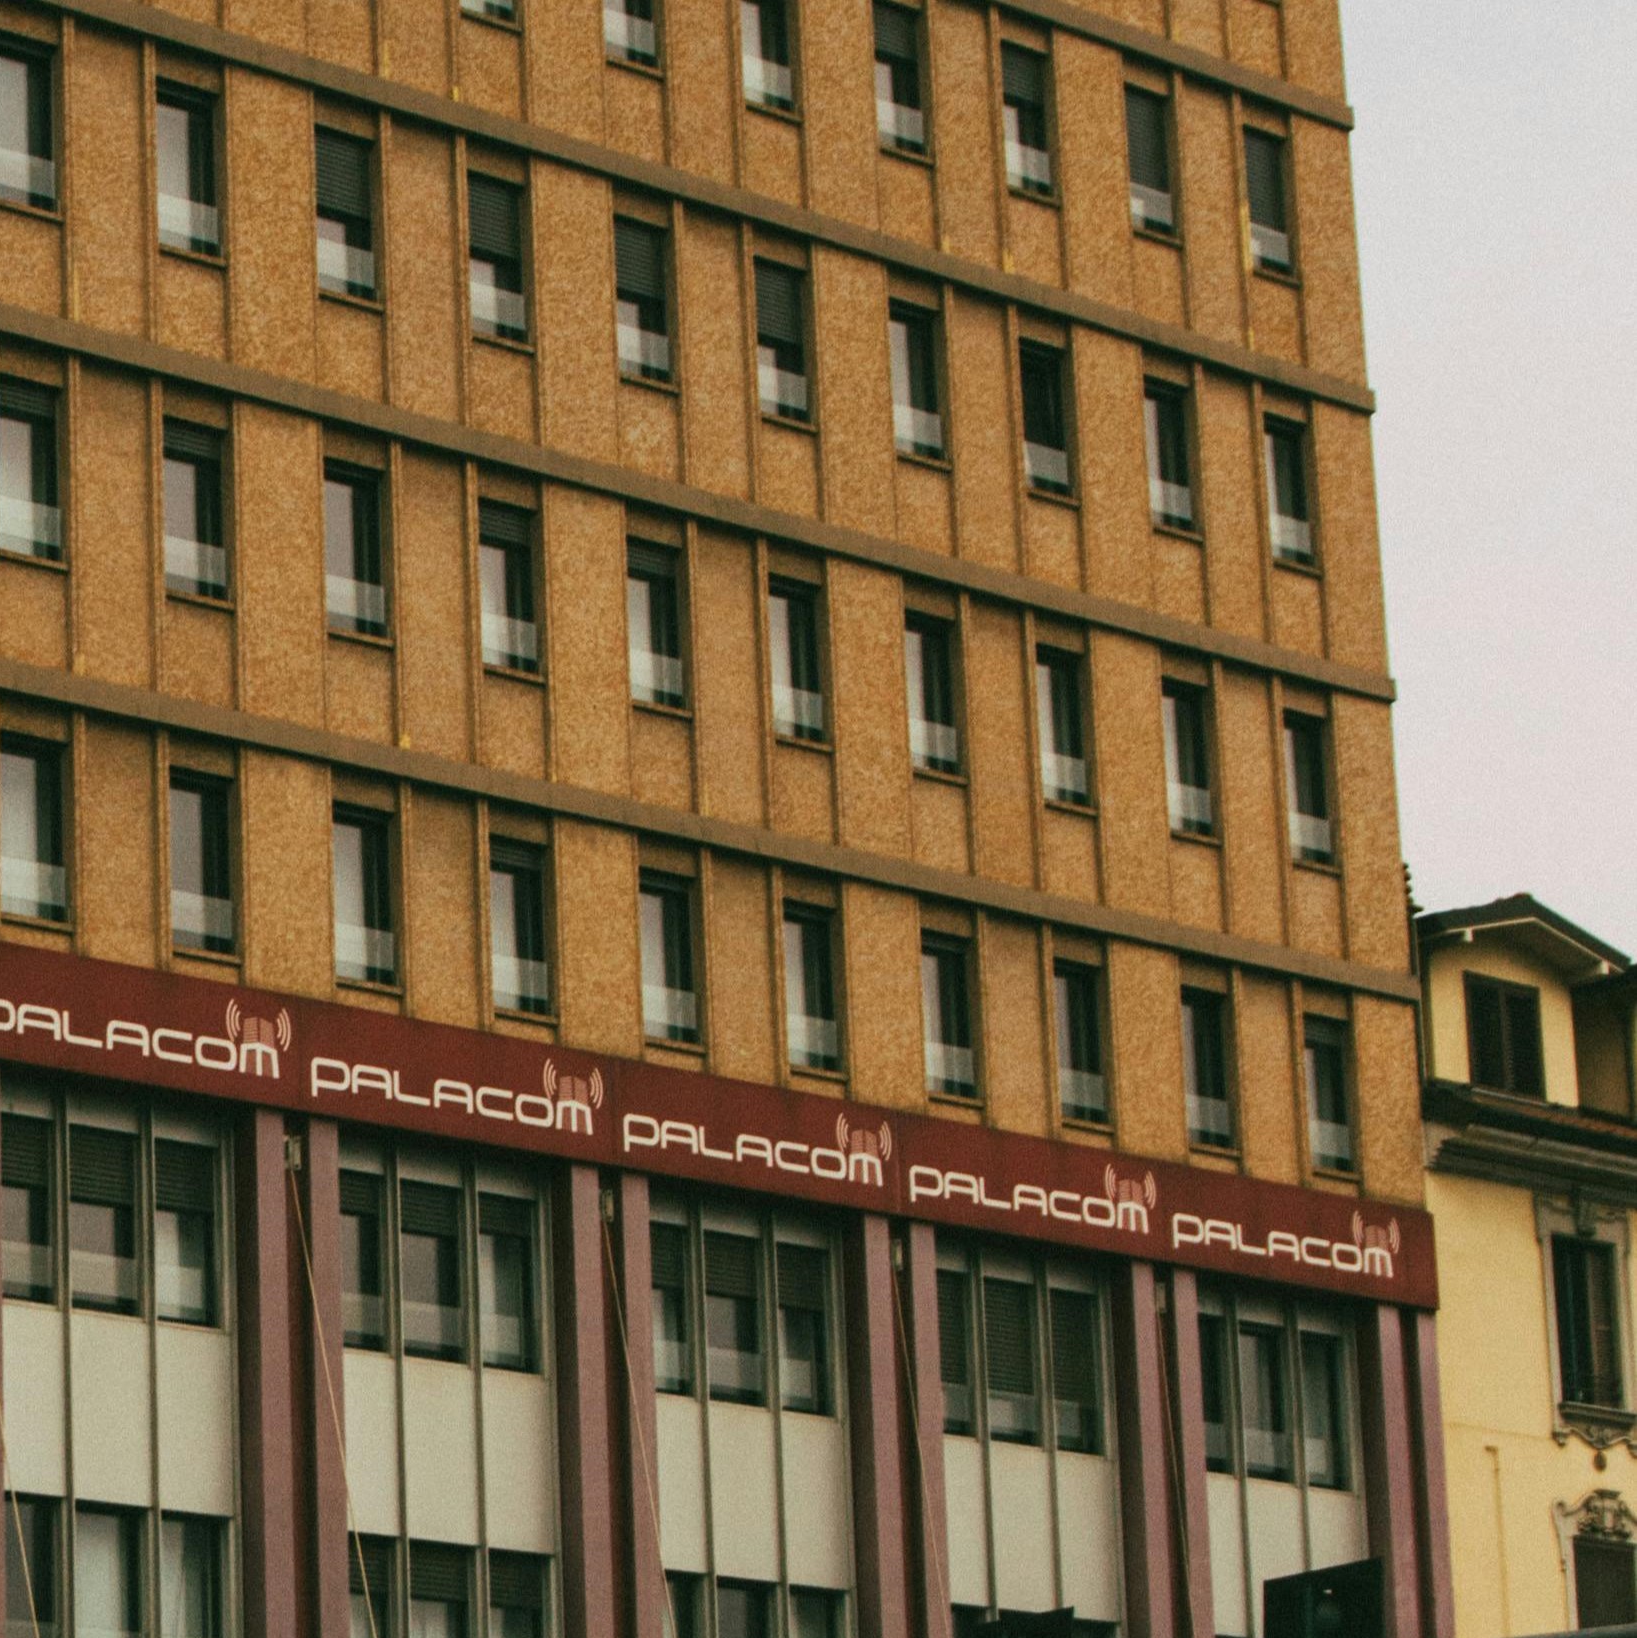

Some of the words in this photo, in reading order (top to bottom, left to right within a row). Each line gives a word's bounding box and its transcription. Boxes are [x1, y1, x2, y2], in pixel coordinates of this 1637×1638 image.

[310, 1056, 594, 1136] PALACOM
[623, 1113, 883, 1187] PALACOM
[909, 1164, 1149, 1234] PALACOM
[1172, 1212, 1394, 1278] PALACOM
